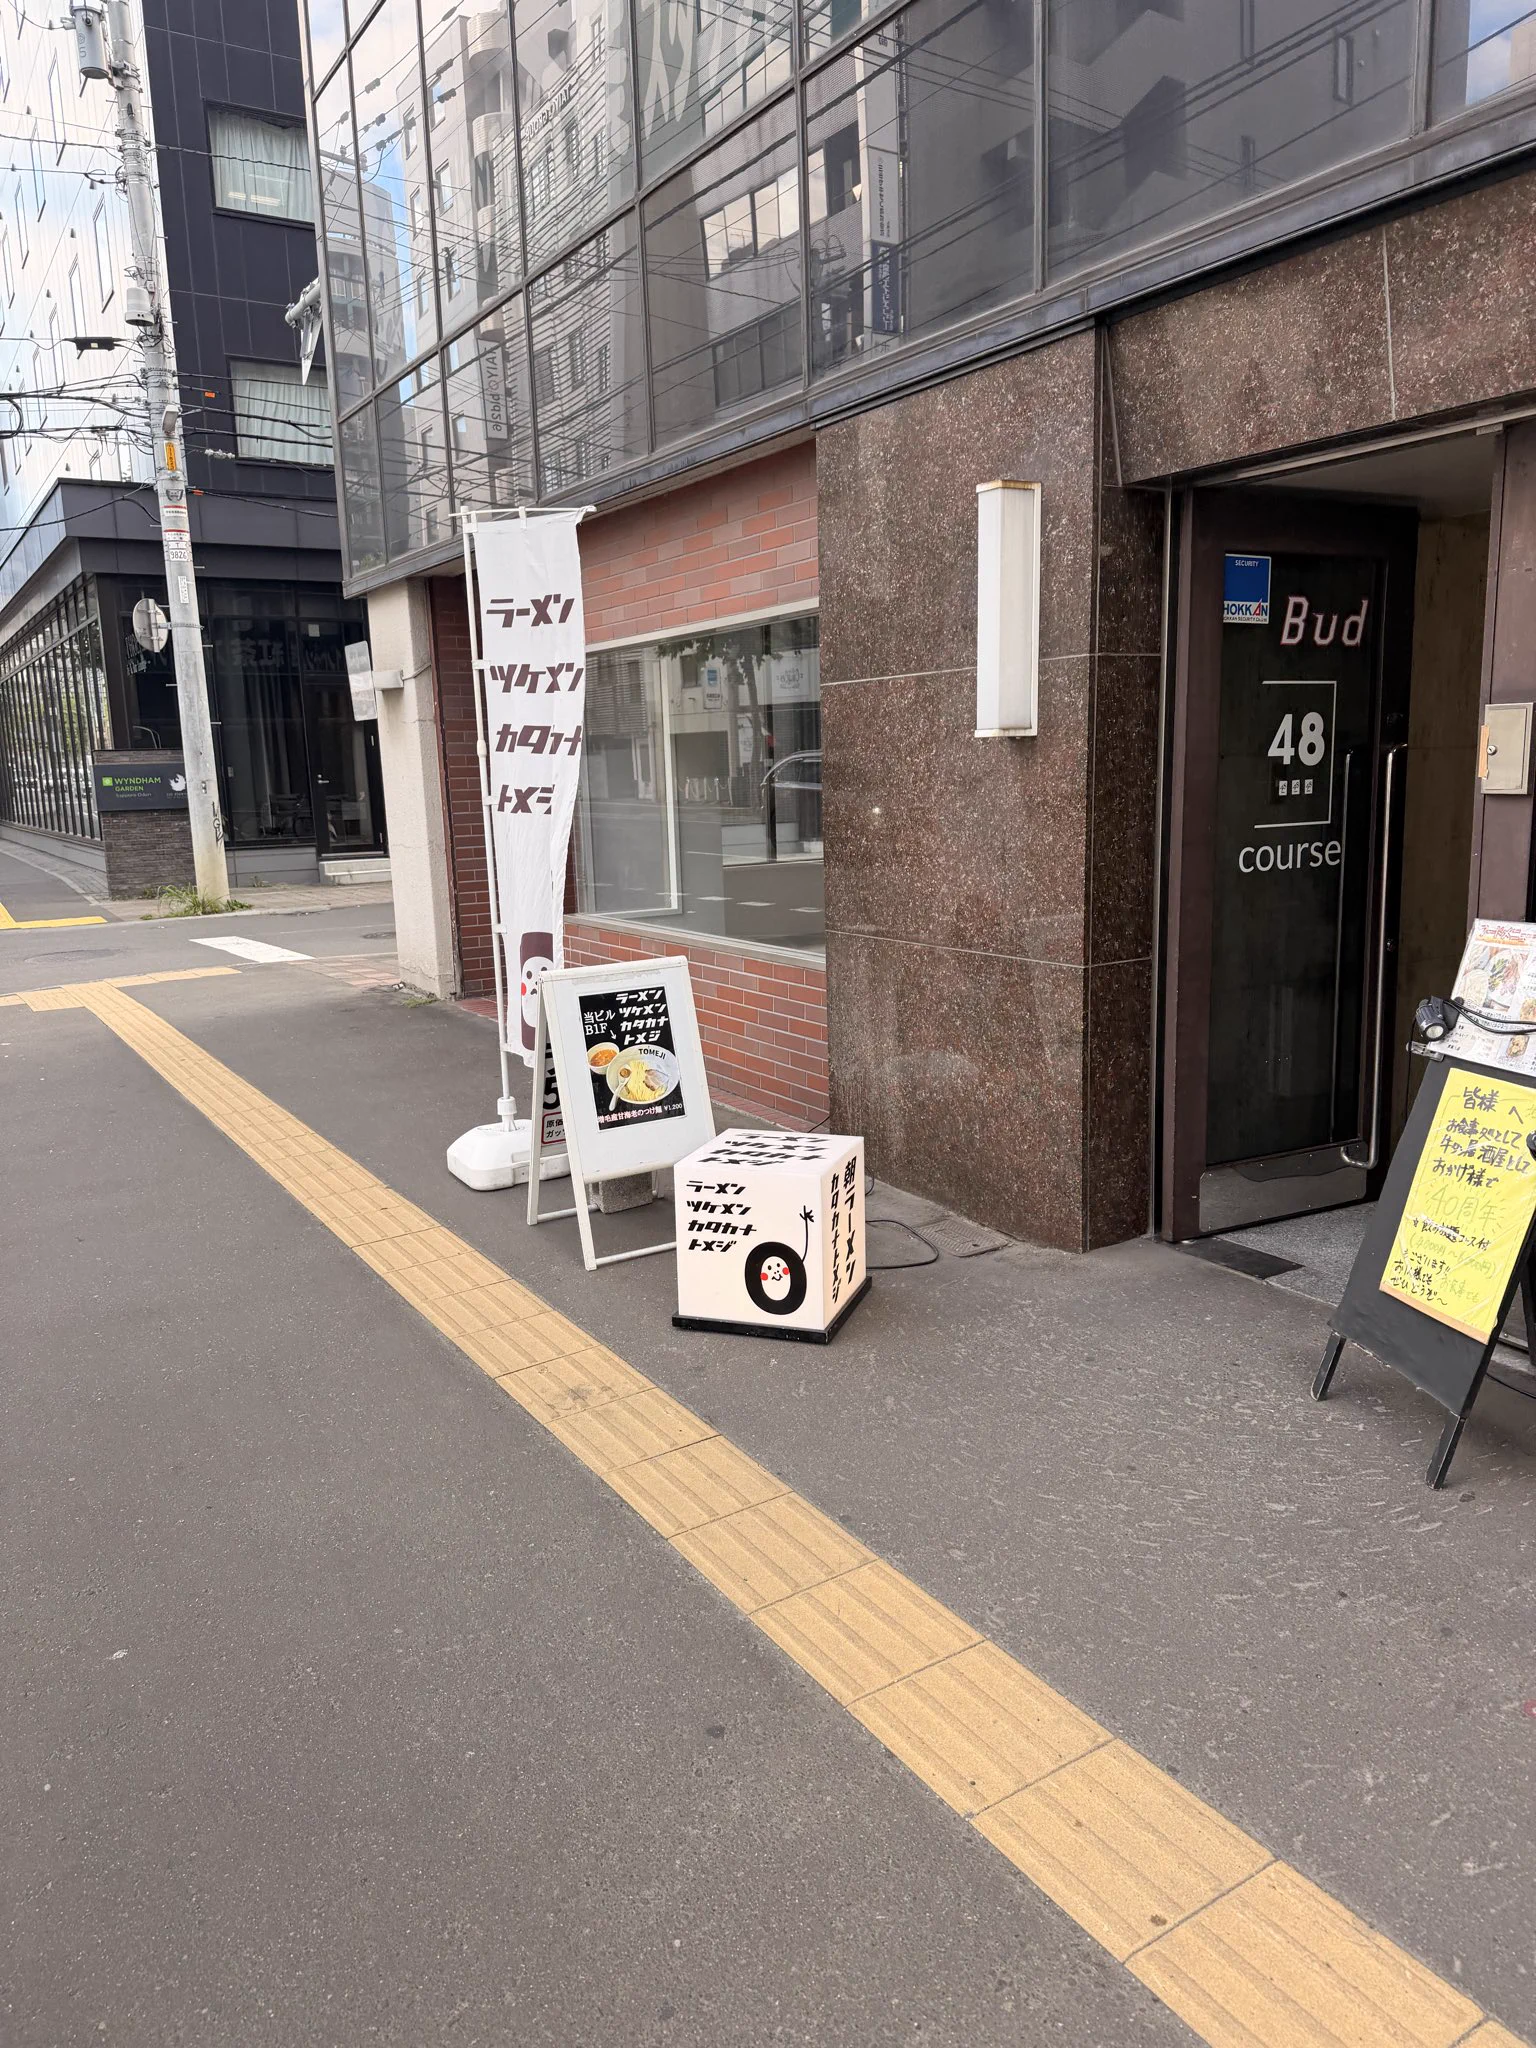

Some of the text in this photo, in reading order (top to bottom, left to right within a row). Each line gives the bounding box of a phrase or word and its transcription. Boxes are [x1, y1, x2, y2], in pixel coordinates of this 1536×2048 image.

[170, 551, 188, 560] 9826
[486, 593, 575, 628] ラーメン
[1281, 595, 1369, 647] Bud
[489, 662, 585, 694] ツケメン
[1268, 711, 1326, 767] 48
[1238, 840, 1342, 873] course
[616, 990, 663, 1004] ラーメン
[583, 1009, 616, 1024] 当ビル
[618, 1003, 667, 1018] ツケメン
[584, 1023, 608, 1036] B1F
[619, 1016, 669, 1032] カタカナ
[623, 1030, 661, 1046] トメジ
[638, 1048, 667, 1060] TOMEJI
[737, 1132, 832, 1143] ラーメン
[725, 1140, 830, 1151] ツケメン
[698, 1156, 785, 1167] トメジ
[710, 1149, 828, 1161] カタカナ
[686, 1180, 746, 1195] ラーメン
[686, 1200, 752, 1215] ツケメン
[687, 1219, 757, 1236] カタカナ
[843, 1155, 857, 1285] 朝ラーメン
[688, 1238, 737, 1252] トメジ
[830, 1172, 842, 1304] カタカナトメジ
